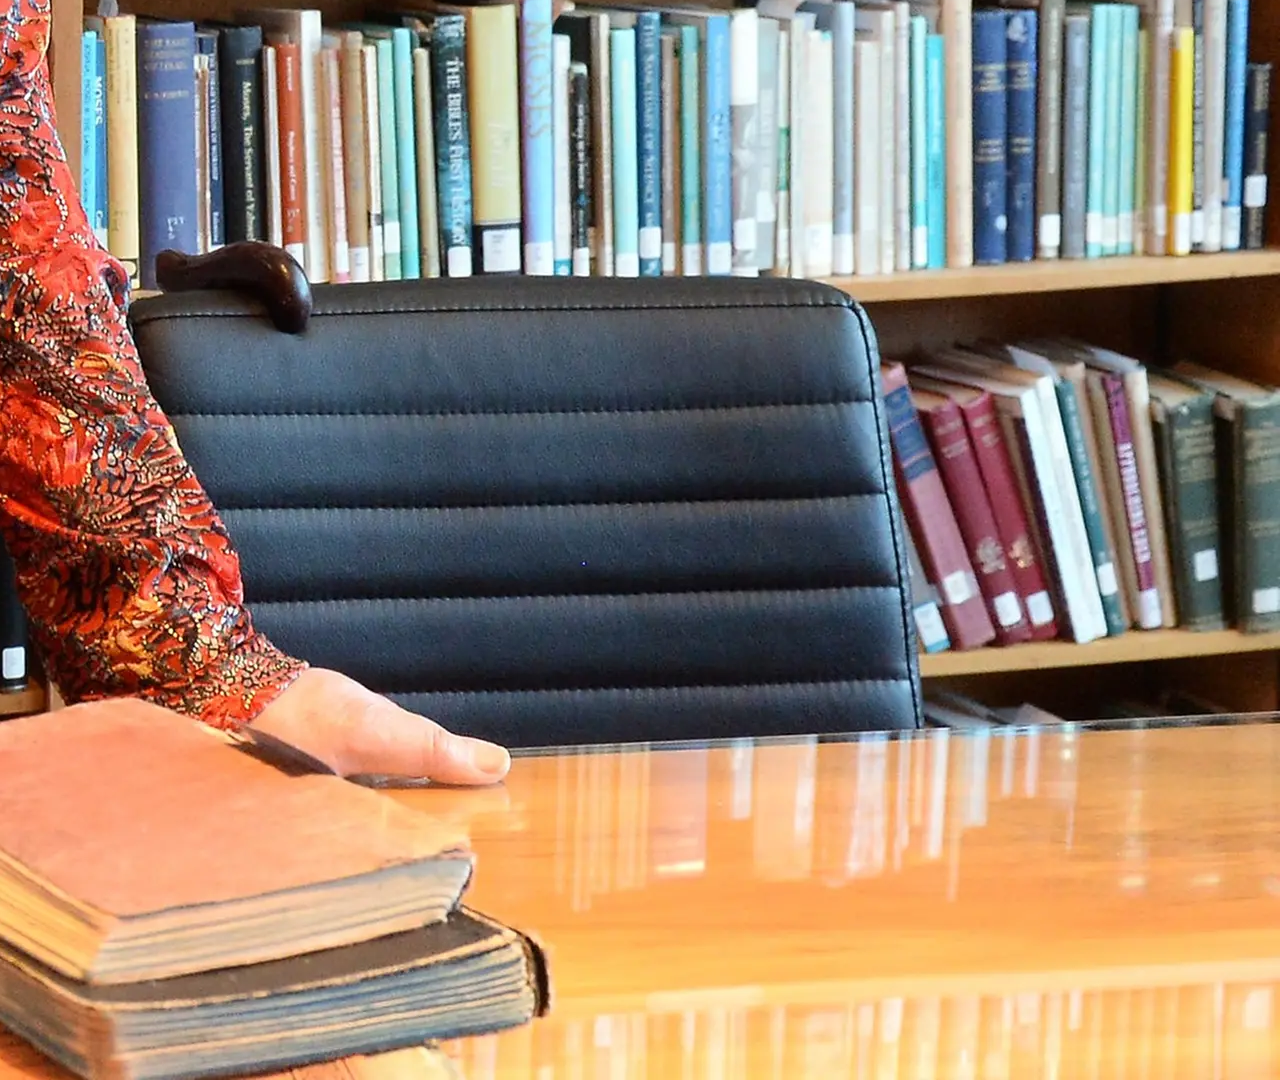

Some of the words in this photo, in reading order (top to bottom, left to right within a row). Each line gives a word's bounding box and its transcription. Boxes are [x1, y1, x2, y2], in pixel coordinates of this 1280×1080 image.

[446, 56, 465, 89] THE
[242, 81, 253, 120] Moses,
[245, 125, 254, 147] The
[244, 148, 255, 187] Servant
